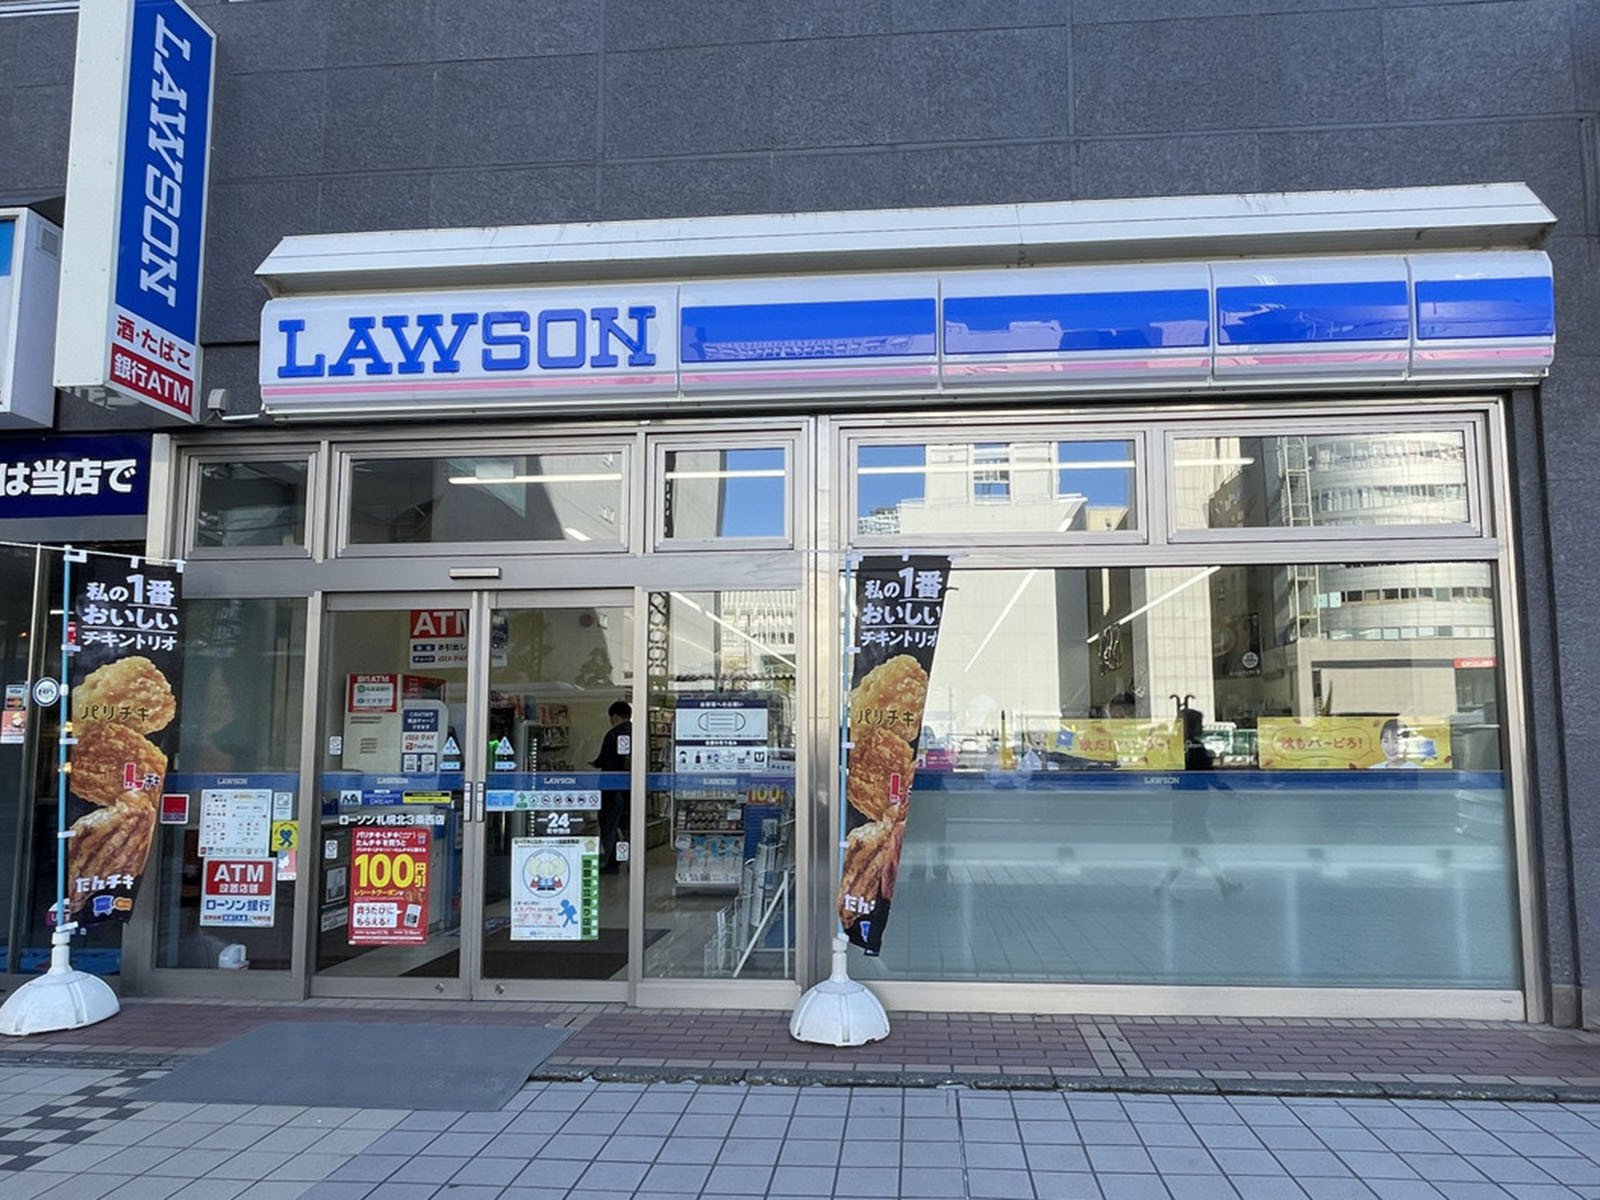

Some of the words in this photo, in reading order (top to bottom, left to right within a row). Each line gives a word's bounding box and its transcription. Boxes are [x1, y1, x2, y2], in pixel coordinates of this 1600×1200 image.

[140, 13, 191, 307] LAWSON
[117, 315, 191, 371] 酒・たばこ
[277, 305, 656, 379] LAWSON
[114, 353, 190, 407] 銀行ATM
[0, 458, 137, 496] は当店で
[86, 573, 175, 606] 私の1番
[865, 567, 943, 599] 私の1番
[82, 604, 179, 630] おいしい
[861, 602, 942, 625] おいしい
[81, 631, 177, 651] チキントリオ
[81, 705, 150, 722] パリチキ
[857, 709, 914, 727] パリチキ
[76, 874, 135, 893] たんチキ
[214, 863, 264, 882] ATM
[355, 854, 415, 888] 100
[206, 899, 270, 912] ローソン銀行
